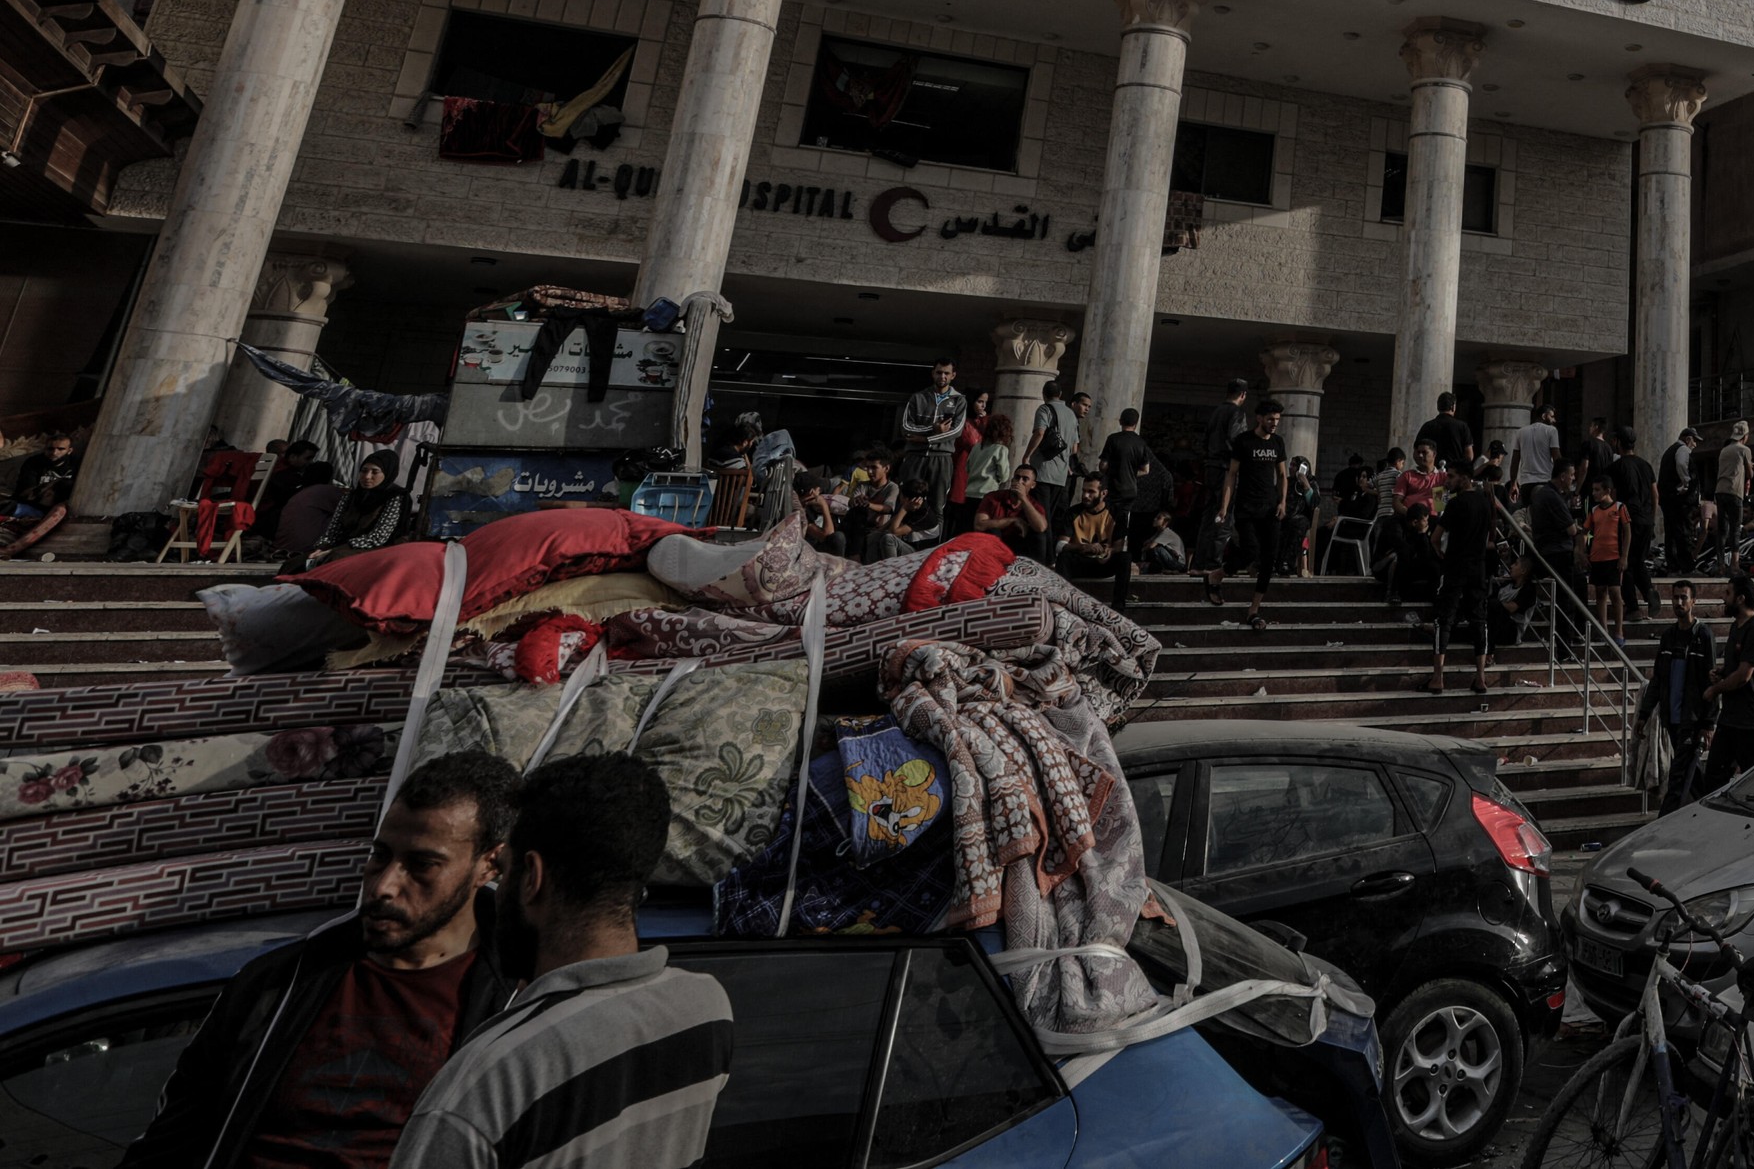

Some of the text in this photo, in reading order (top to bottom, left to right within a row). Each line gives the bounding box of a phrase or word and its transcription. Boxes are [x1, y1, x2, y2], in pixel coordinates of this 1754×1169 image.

[558, 159, 854, 219] AL-QU OSPITAL
[940, 205, 1050, 241] القدس
[1252, 449, 1278, 458] KARL
[512, 470, 596, 500] مشروبات
